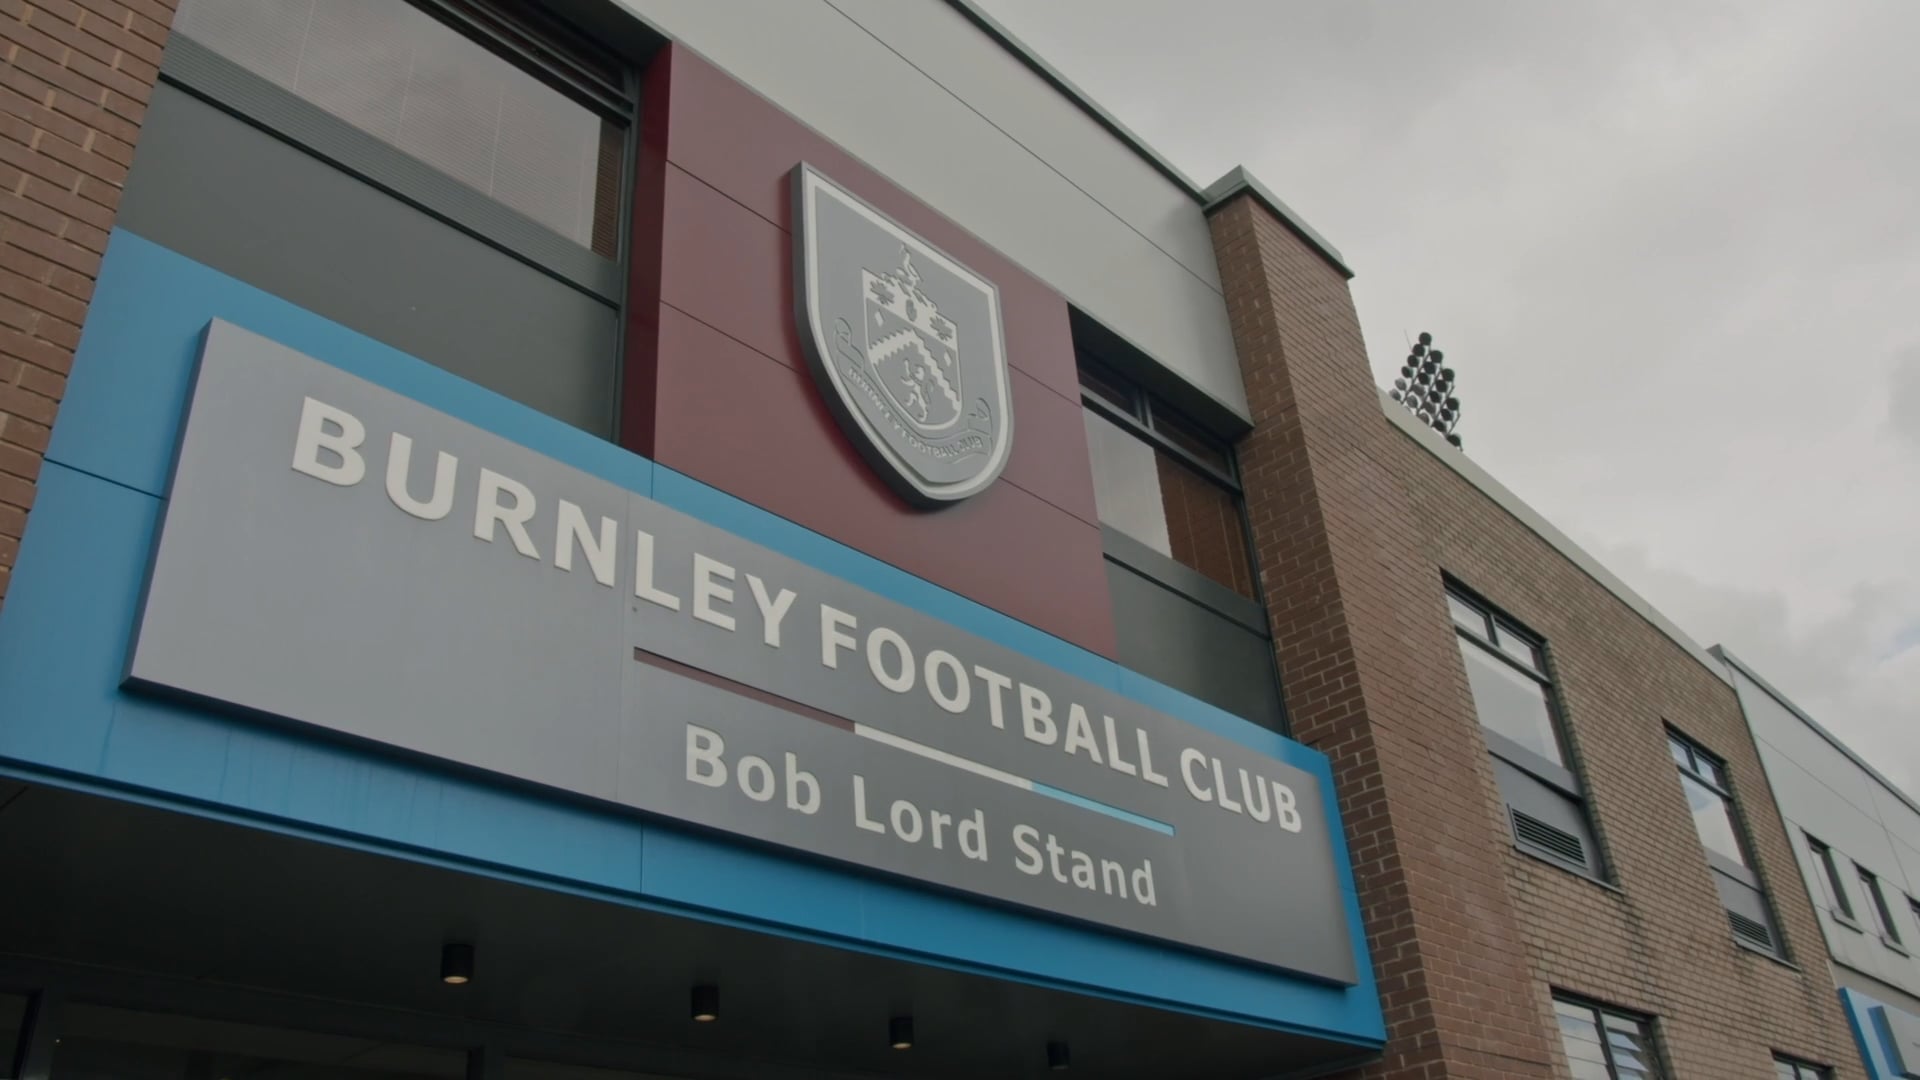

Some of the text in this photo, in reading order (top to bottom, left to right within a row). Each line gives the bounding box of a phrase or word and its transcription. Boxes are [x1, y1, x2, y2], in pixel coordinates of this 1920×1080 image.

[291, 396, 1303, 835] BURNLEY FOOTBALL CLUB
[685, 722, 1158, 907] Bob Lord Stand
